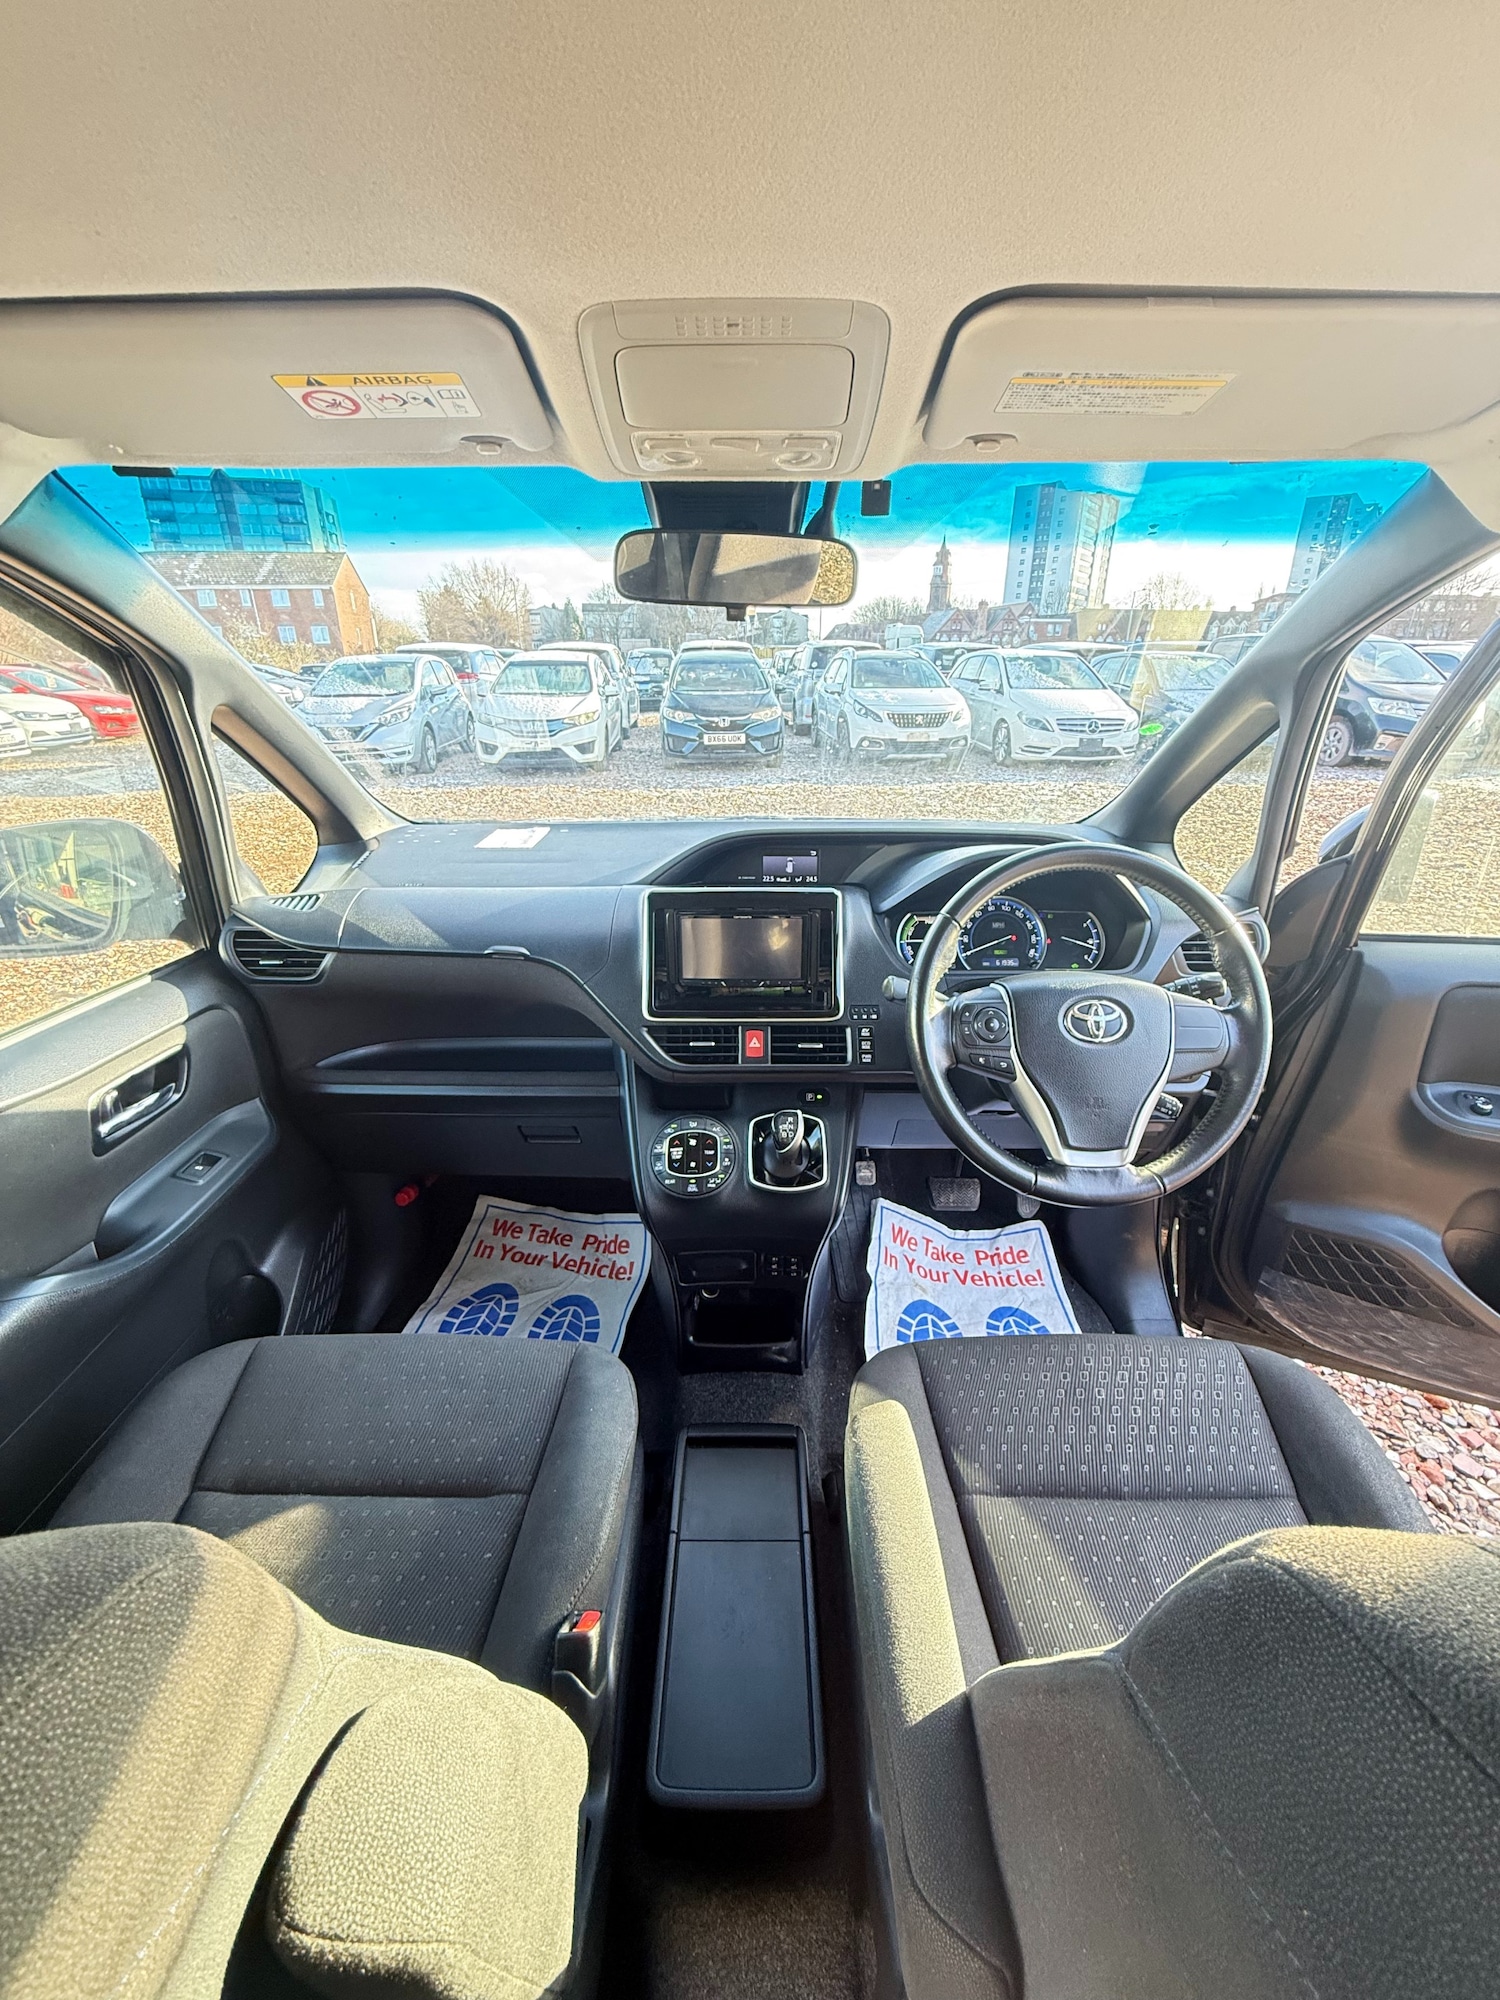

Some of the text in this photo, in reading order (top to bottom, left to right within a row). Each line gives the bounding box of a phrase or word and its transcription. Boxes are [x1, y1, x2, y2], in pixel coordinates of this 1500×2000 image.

[353, 375, 432, 385] AIRBAG
[492, 1218, 630, 1255] We Take Pride
[891, 1222, 1030, 1267] We Take Pride
[473, 1239, 635, 1281] In Your Vehicle!
[883, 1246, 1046, 1288] In Your Vehicle!
